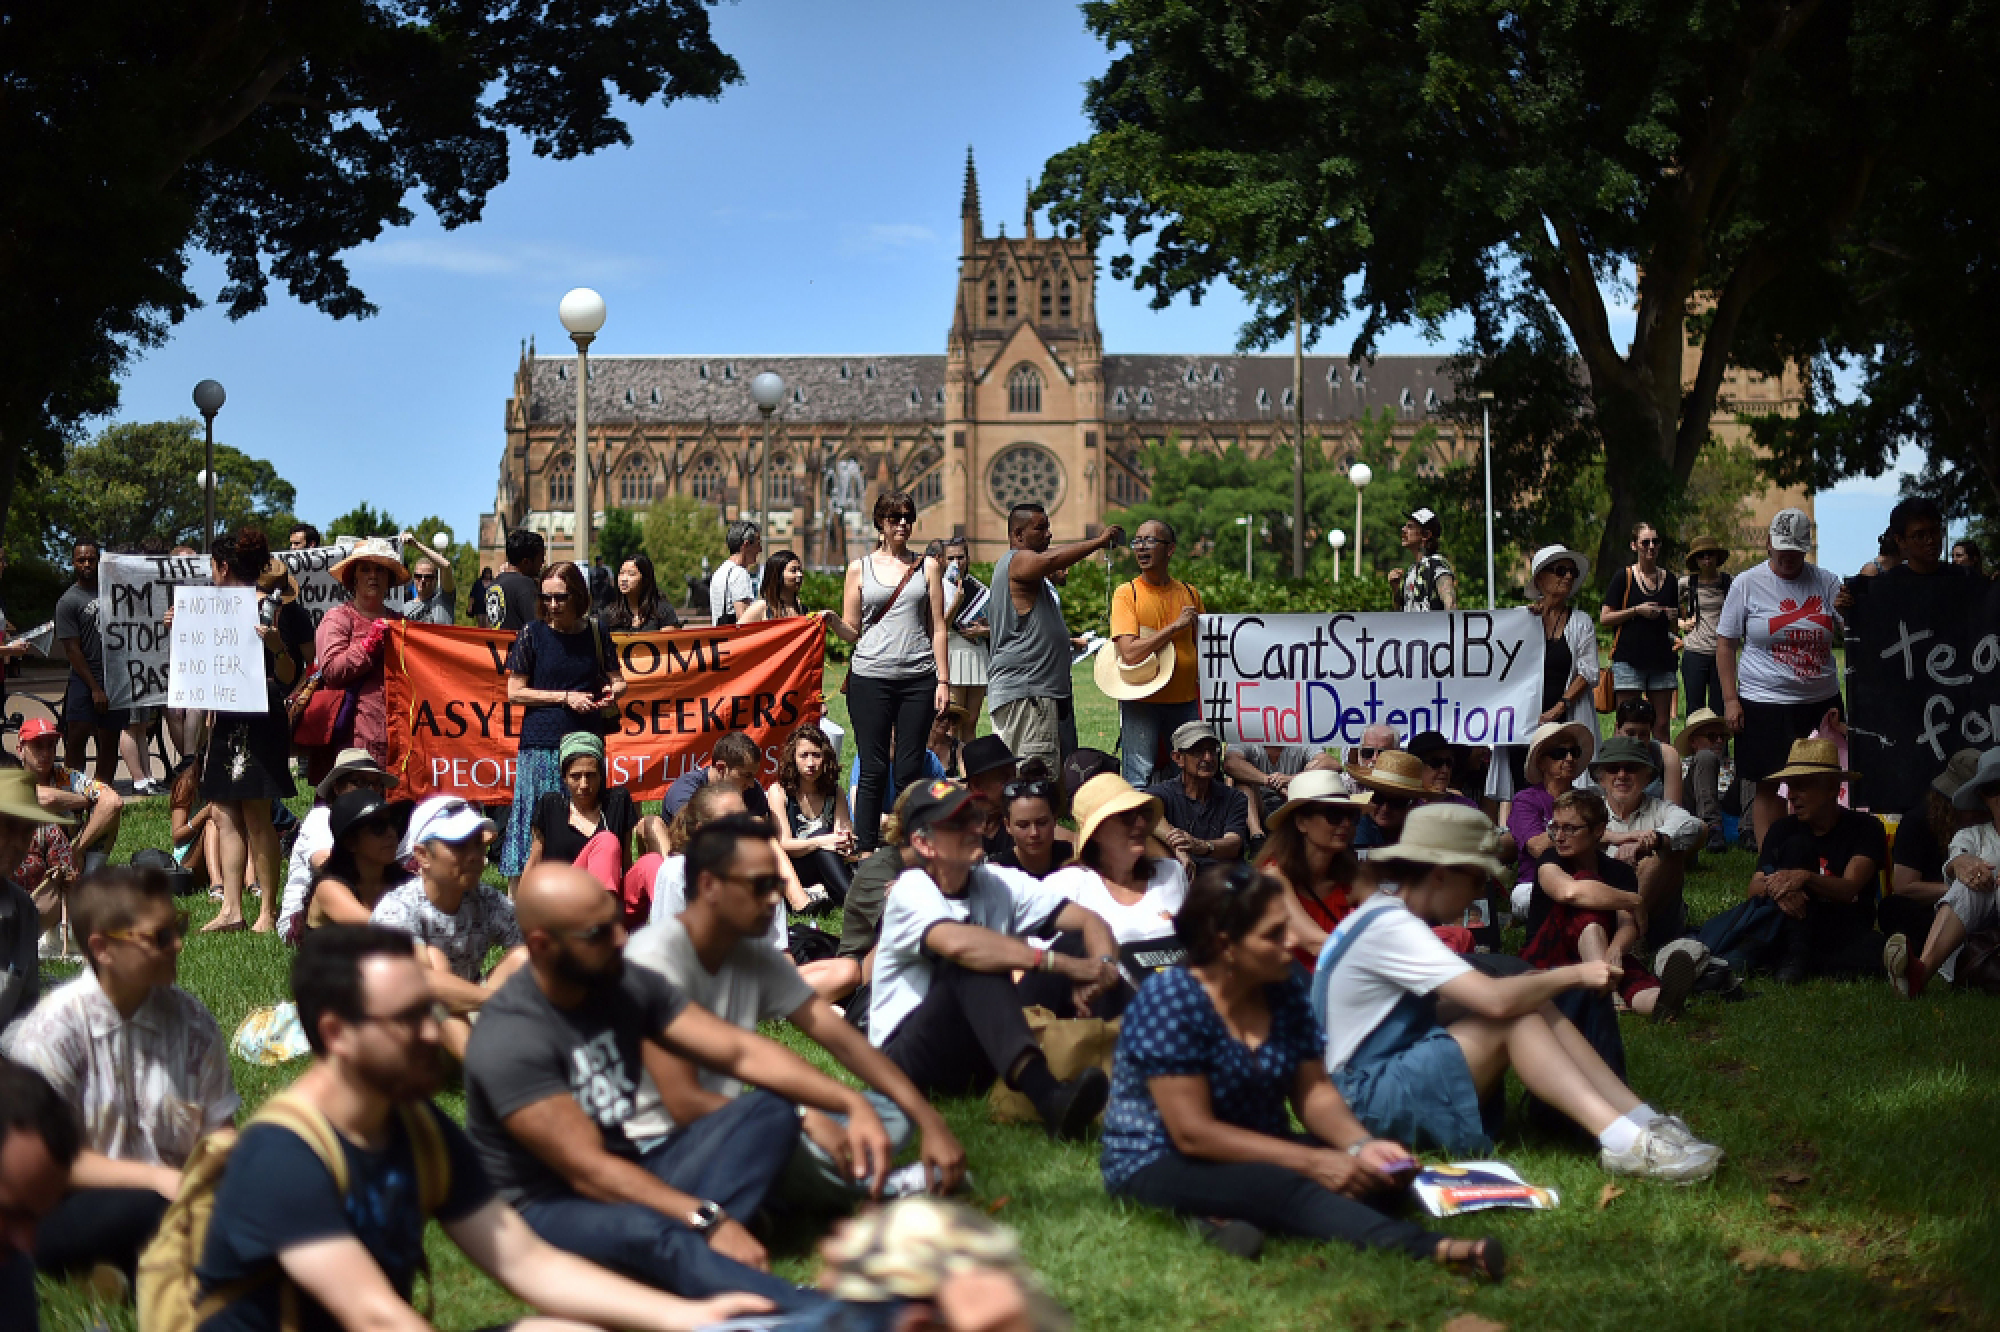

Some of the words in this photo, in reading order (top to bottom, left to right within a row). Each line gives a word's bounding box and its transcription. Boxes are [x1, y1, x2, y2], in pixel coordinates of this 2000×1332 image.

[146, 557, 206, 579] THE
[112, 581, 153, 618] PM
[299, 575, 327, 605] YOU
[106, 620, 170, 652] STOP
[213, 628, 238, 646] BAN
[1202, 611, 1525, 682] #CantStandBy
[213, 654, 246, 678] FEAR
[486, 638, 731, 676] WOME
[213, 684, 237, 702] HATE
[625, 690, 800, 736] SEEKERS
[1204, 681, 1516, 744] #EndDetention
